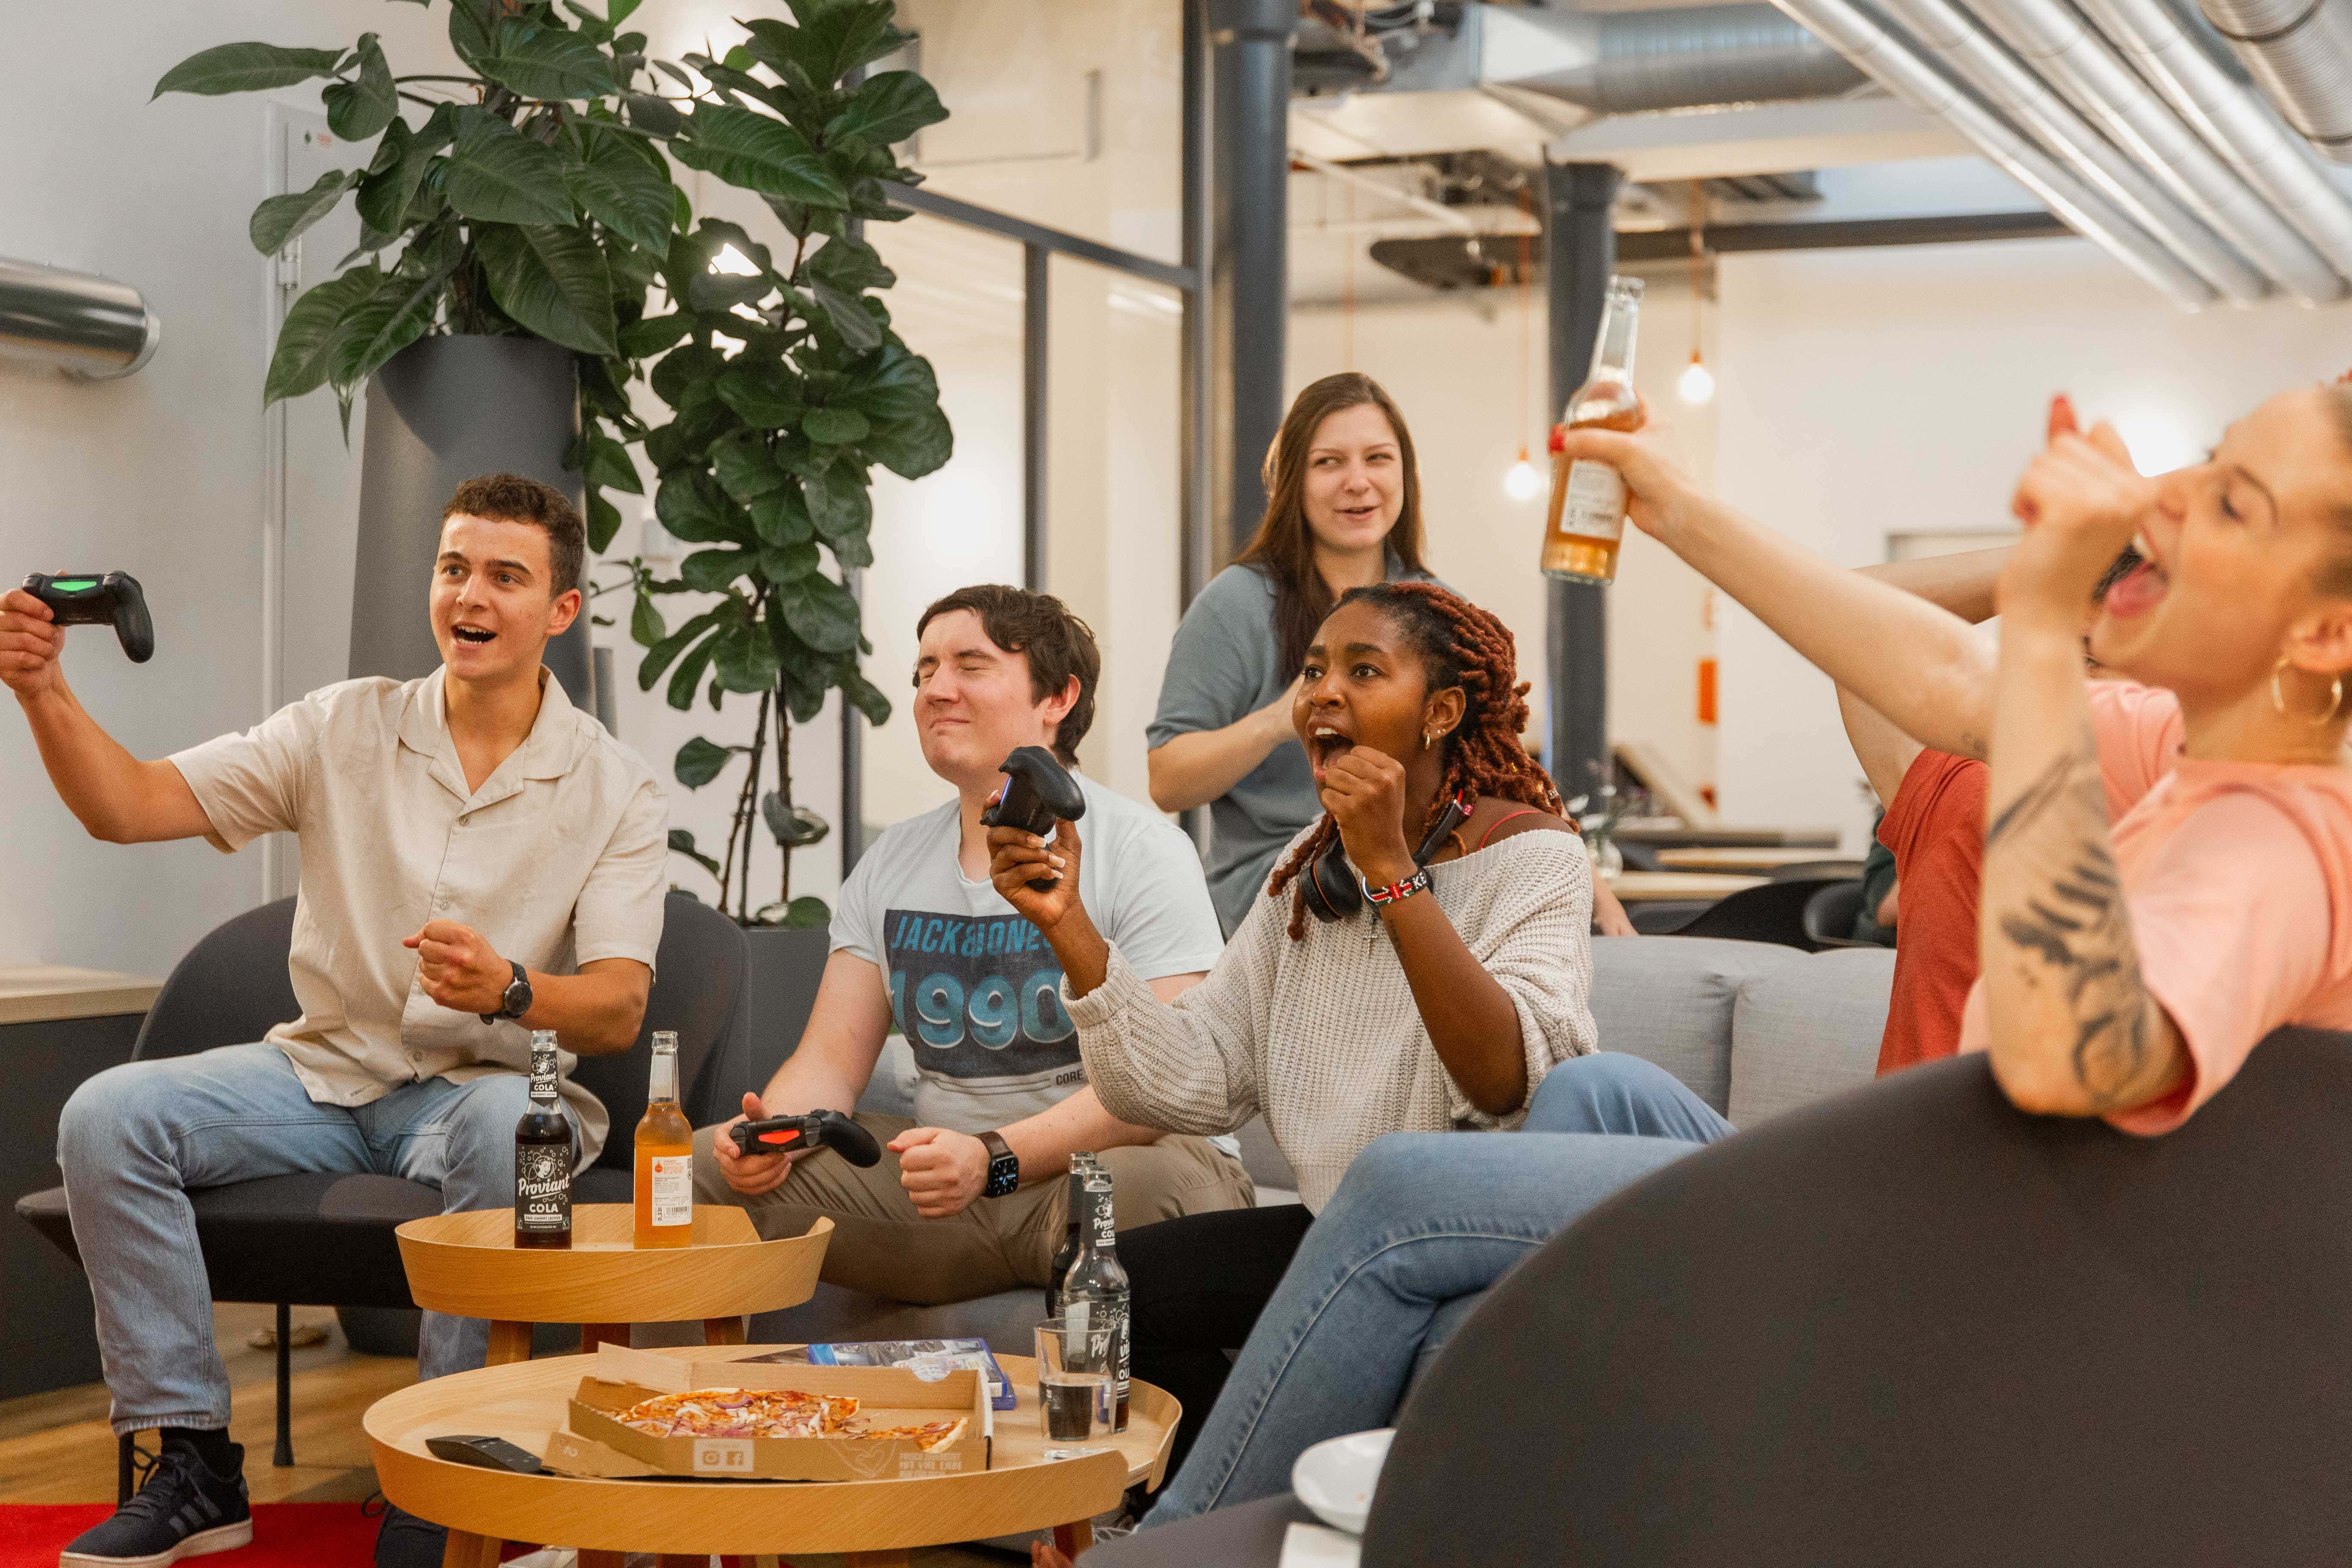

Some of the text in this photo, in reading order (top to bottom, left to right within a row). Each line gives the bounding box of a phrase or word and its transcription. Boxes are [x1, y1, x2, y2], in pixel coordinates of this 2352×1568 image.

[889, 968, 1075, 1050] 1990
[530, 1070, 557, 1083] Proviant
[518, 1173, 570, 1197] Proviant
[529, 1204, 558, 1213] COLA
